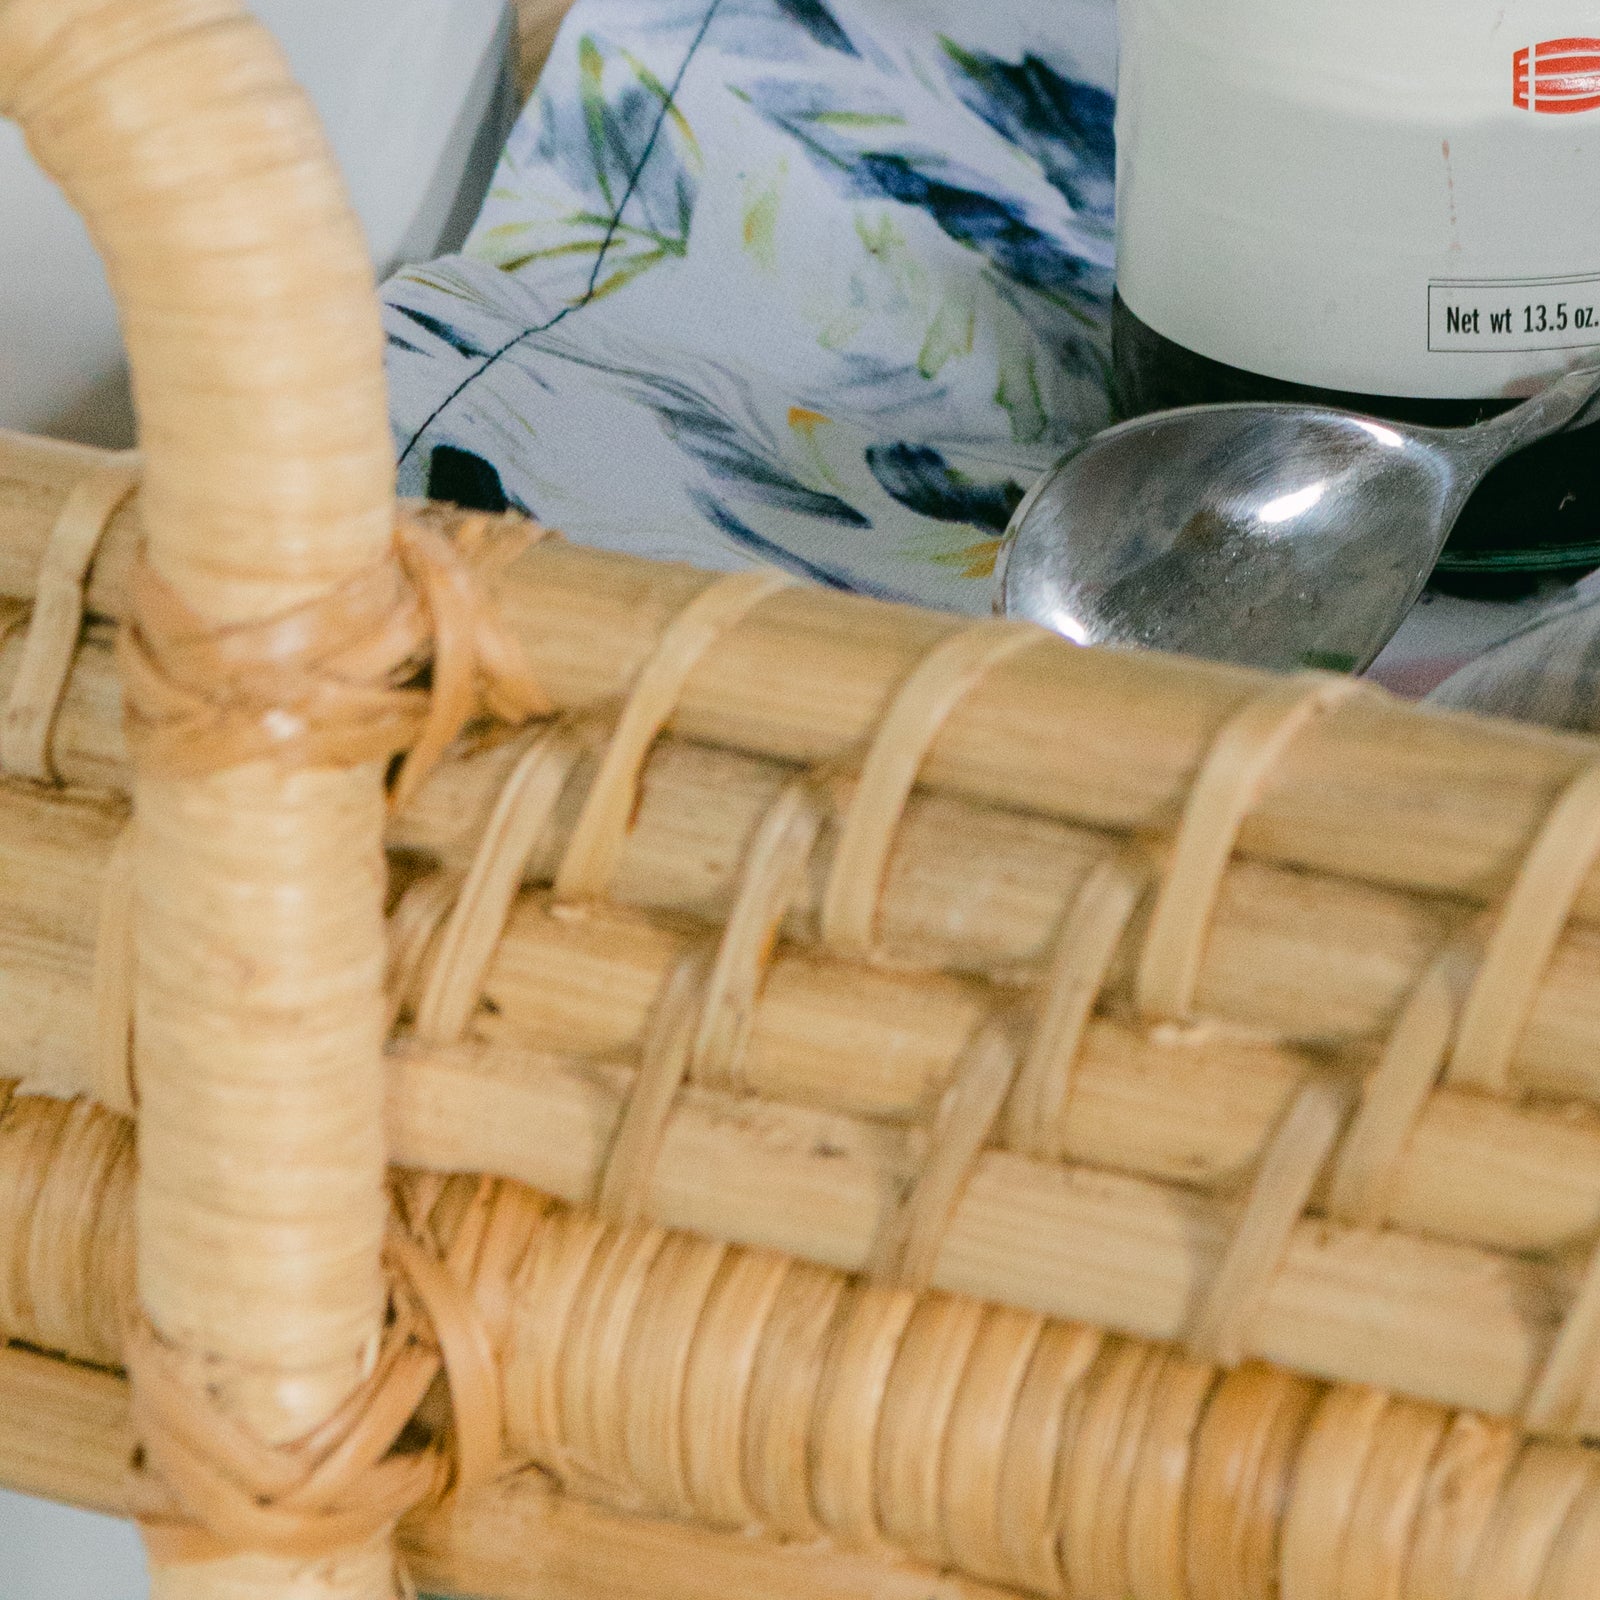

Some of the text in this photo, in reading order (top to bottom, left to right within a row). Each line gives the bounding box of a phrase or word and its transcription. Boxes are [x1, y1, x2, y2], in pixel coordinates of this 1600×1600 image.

[1446, 306, 1480, 334] Net
[1489, 308, 1513, 334] wt
[1523, 303, 1568, 333] 13.5
[1574, 306, 1600, 330] oz.
